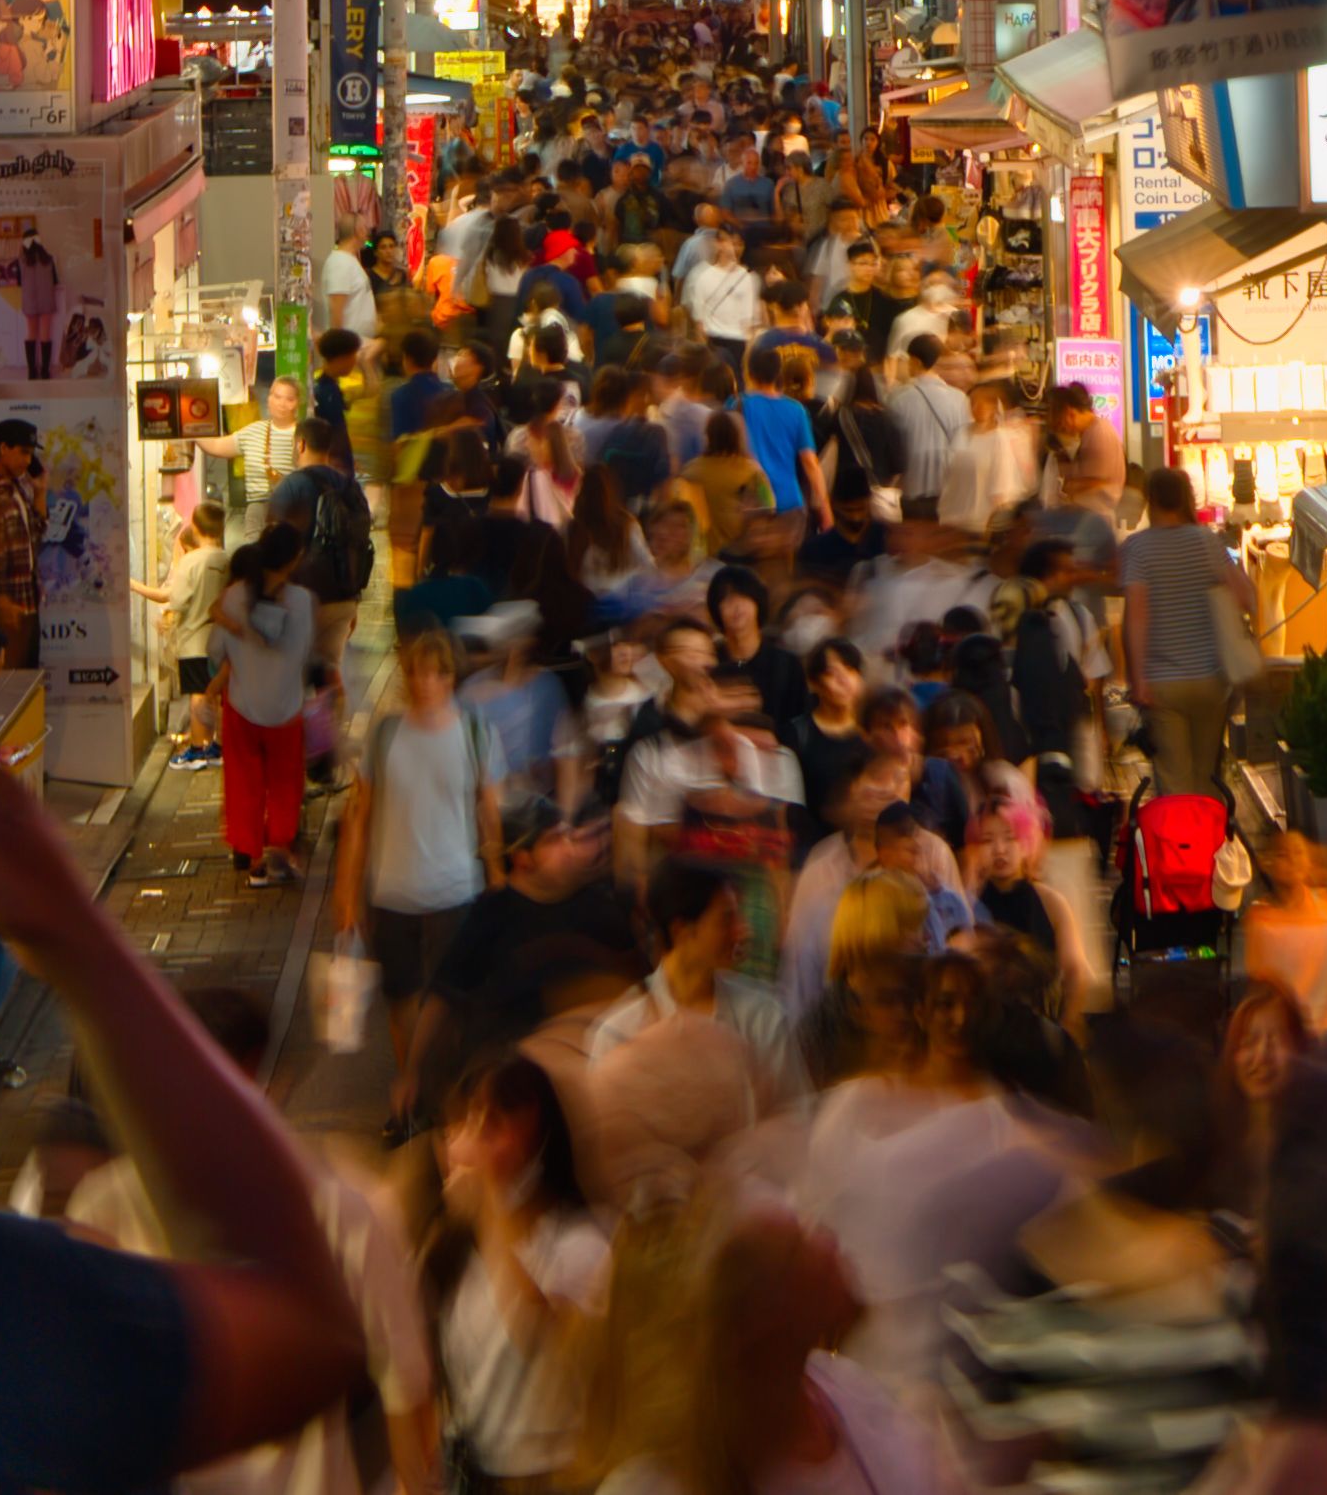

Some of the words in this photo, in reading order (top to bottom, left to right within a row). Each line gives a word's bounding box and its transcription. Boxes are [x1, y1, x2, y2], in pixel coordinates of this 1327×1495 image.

[46, 109, 67, 125] 6F
[1133, 176, 1182, 189] Rental
[1133, 192, 1169, 205] Coin
